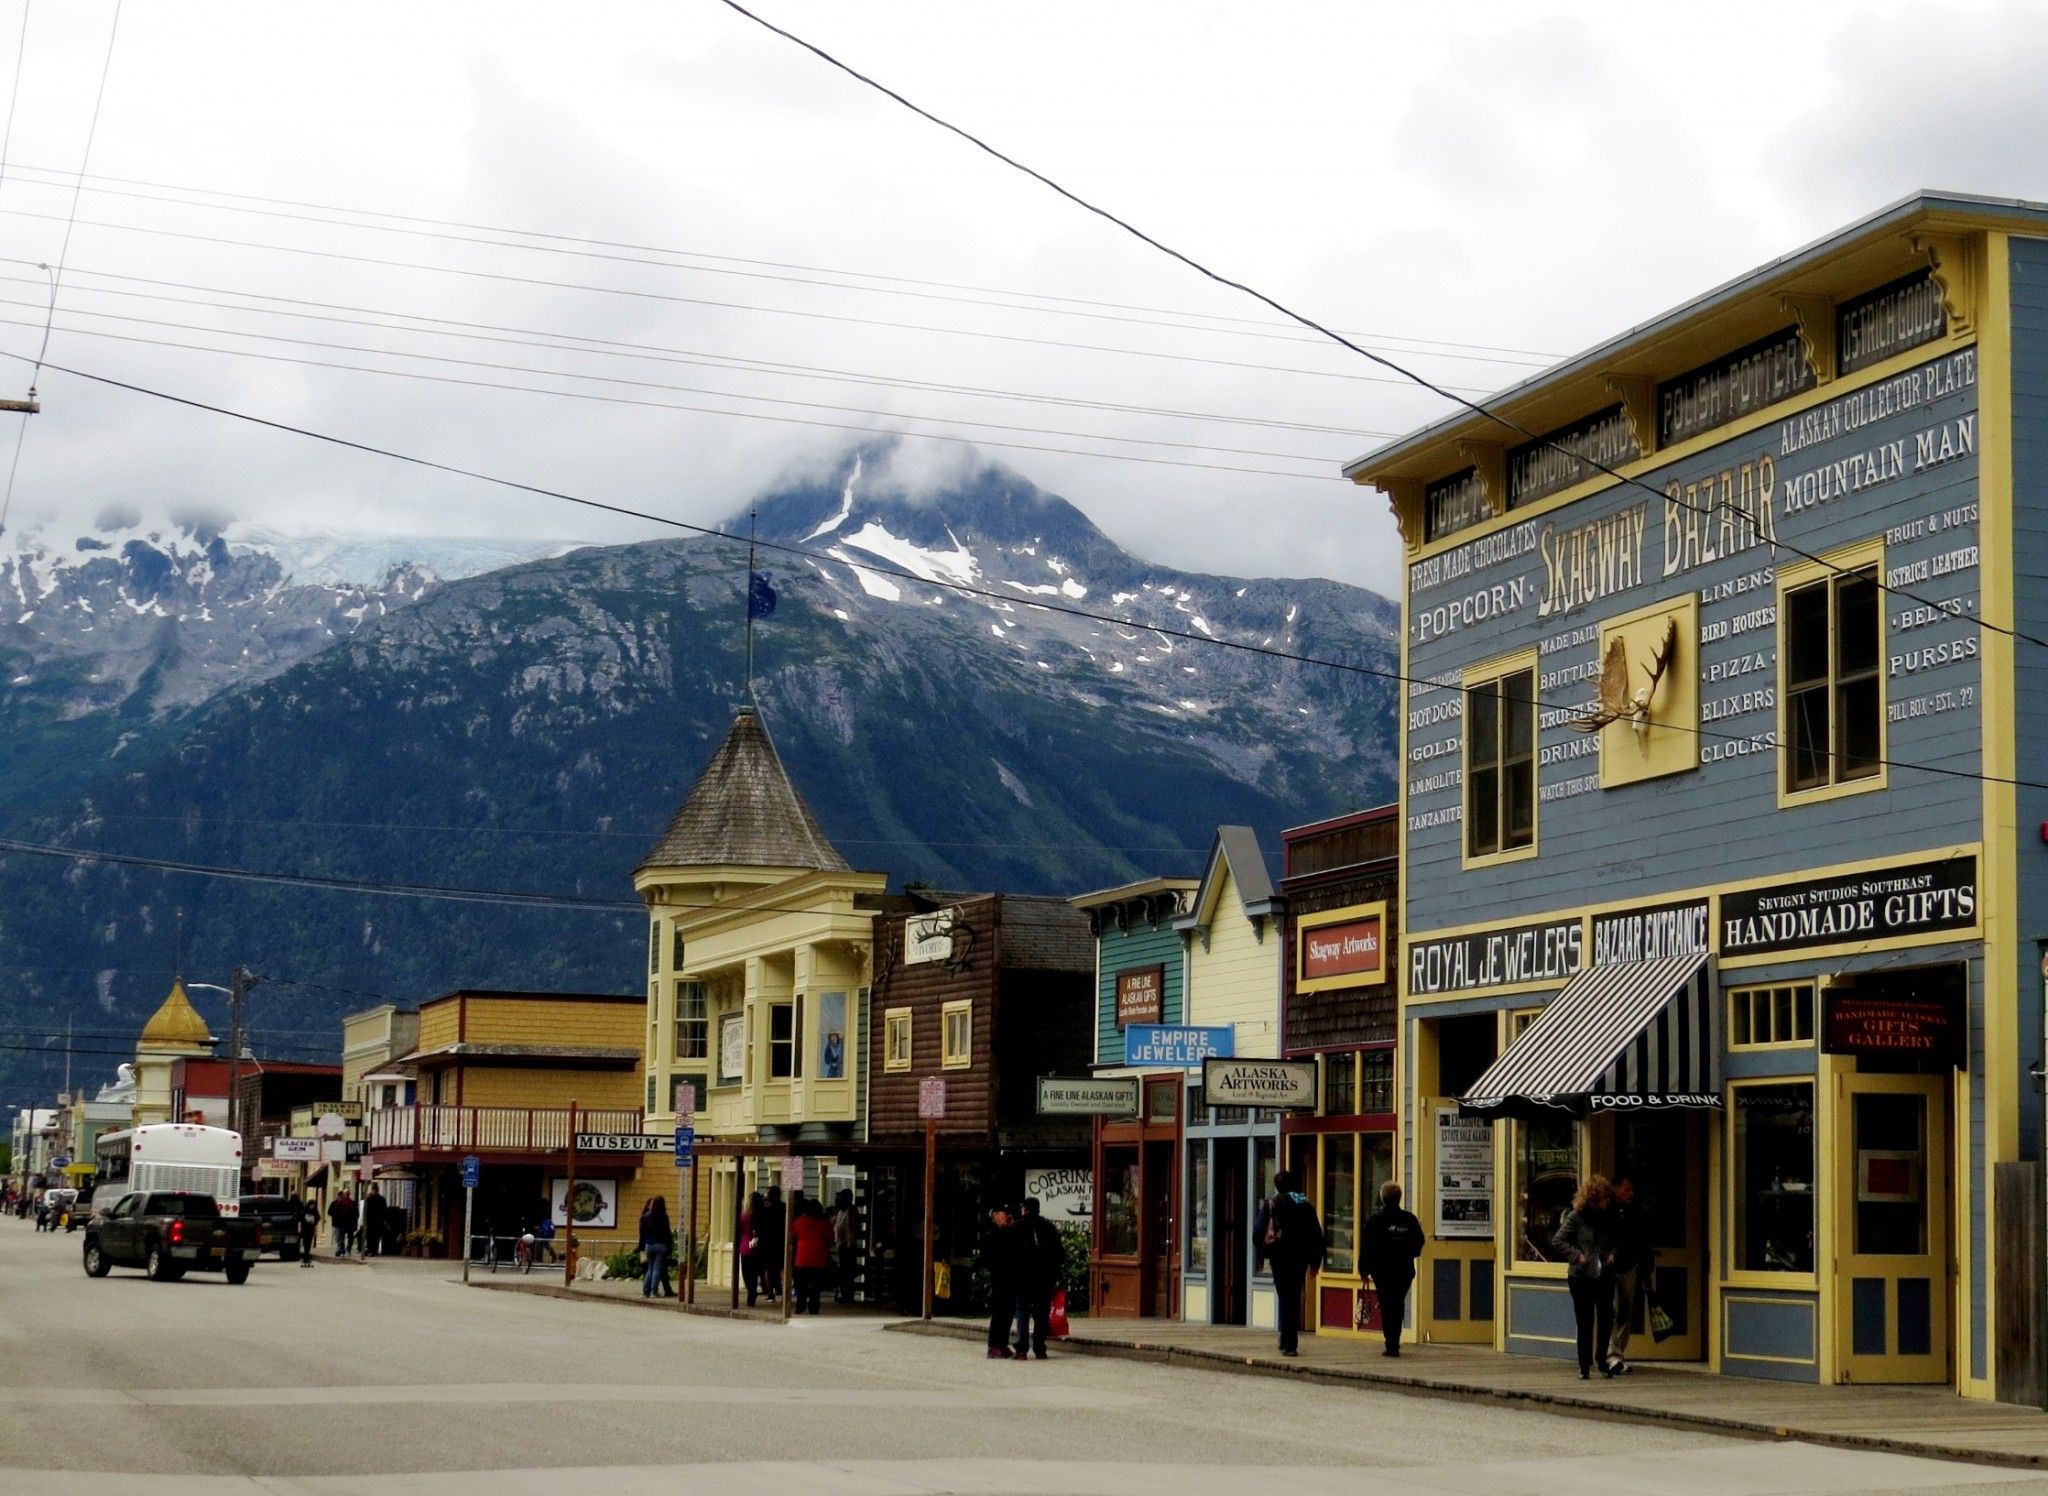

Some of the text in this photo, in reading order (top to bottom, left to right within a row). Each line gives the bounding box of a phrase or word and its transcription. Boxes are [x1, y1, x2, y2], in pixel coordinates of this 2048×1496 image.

[1843, 278, 1942, 362] OSTRICH GOODS
[1664, 371, 1721, 435] POLISH
[1780, 350, 1975, 456] ALASKAN COLLECTOR PLATE
[1511, 431, 1580, 497] KLONDIKE
[1784, 415, 1975, 513] MOUNTAIN MAN
[1537, 454, 1777, 618] SKAGWAY BAZAAR
[1886, 504, 1977, 546] FRUIT & NUTS
[1411, 521, 1537, 592] FRESH MADE CHOCOLATES
[1886, 546, 1978, 589] OSTRICH LEATHER
[1701, 567, 1774, 603] LINENS
[1418, 576, 1527, 641] POPCORN
[1901, 598, 1962, 628] BELTS
[1701, 605, 1776, 643] BIRD HOUSES
[1540, 624, 1600, 655] MADE DAILY
[1710, 652, 1766, 682] PIZZA
[1889, 637, 1977, 677] PURSES
[1540, 660, 1601, 690] BRITTLES
[1409, 699, 1462, 730] HOT DOGS
[1702, 688, 1774, 722] ELIXERS
[1888, 702, 1907, 722] PILL
[1909, 698, 1927, 716] BOX
[1935, 692, 1956, 712] EST.
[1413, 738, 1457, 761] GOLD
[1540, 735, 1600, 765] DRINKS
[1700, 732, 1776, 763] CLOCKS
[1409, 769, 1462, 796] AMMOLITE
[1539, 782, 1565, 800] WATCH
[1566, 778, 1583, 795] THIS
[1409, 805, 1462, 831] TANZANITE
[1758, 875, 1933, 911] SEVIGNY STUDIOS SOUTHEAST
[1724, 885, 1975, 948] HANDMADE GIFTS
[1310, 932, 1377, 962] Skagway Artworks
[1595, 905, 1708, 967] BAZAAR ENTRANCE
[1412, 924, 1582, 993] ROYAL JEWELERS
[1835, 1010, 1897, 1020] HANDMADE
[1864, 1020, 1919, 1032] GIFTS
[1132, 1045, 1217, 1061] JEWELERS
[1151, 1030, 1209, 1046] EMPIRE
[1849, 1033, 1933, 1048] GALLERY
[1219, 1074, 1298, 1092] ARTWORKS
[1231, 1067, 1288, 1079] ALASKA
[1043, 1091, 1134, 1101] A FINE LINE ALASKAN GIFTS
[1590, 1095, 1723, 1109] FOOD & DRINK
[580, 1137, 659, 1149] MUSEUM
[1045, 1185, 1085, 1202] ALASKAN
